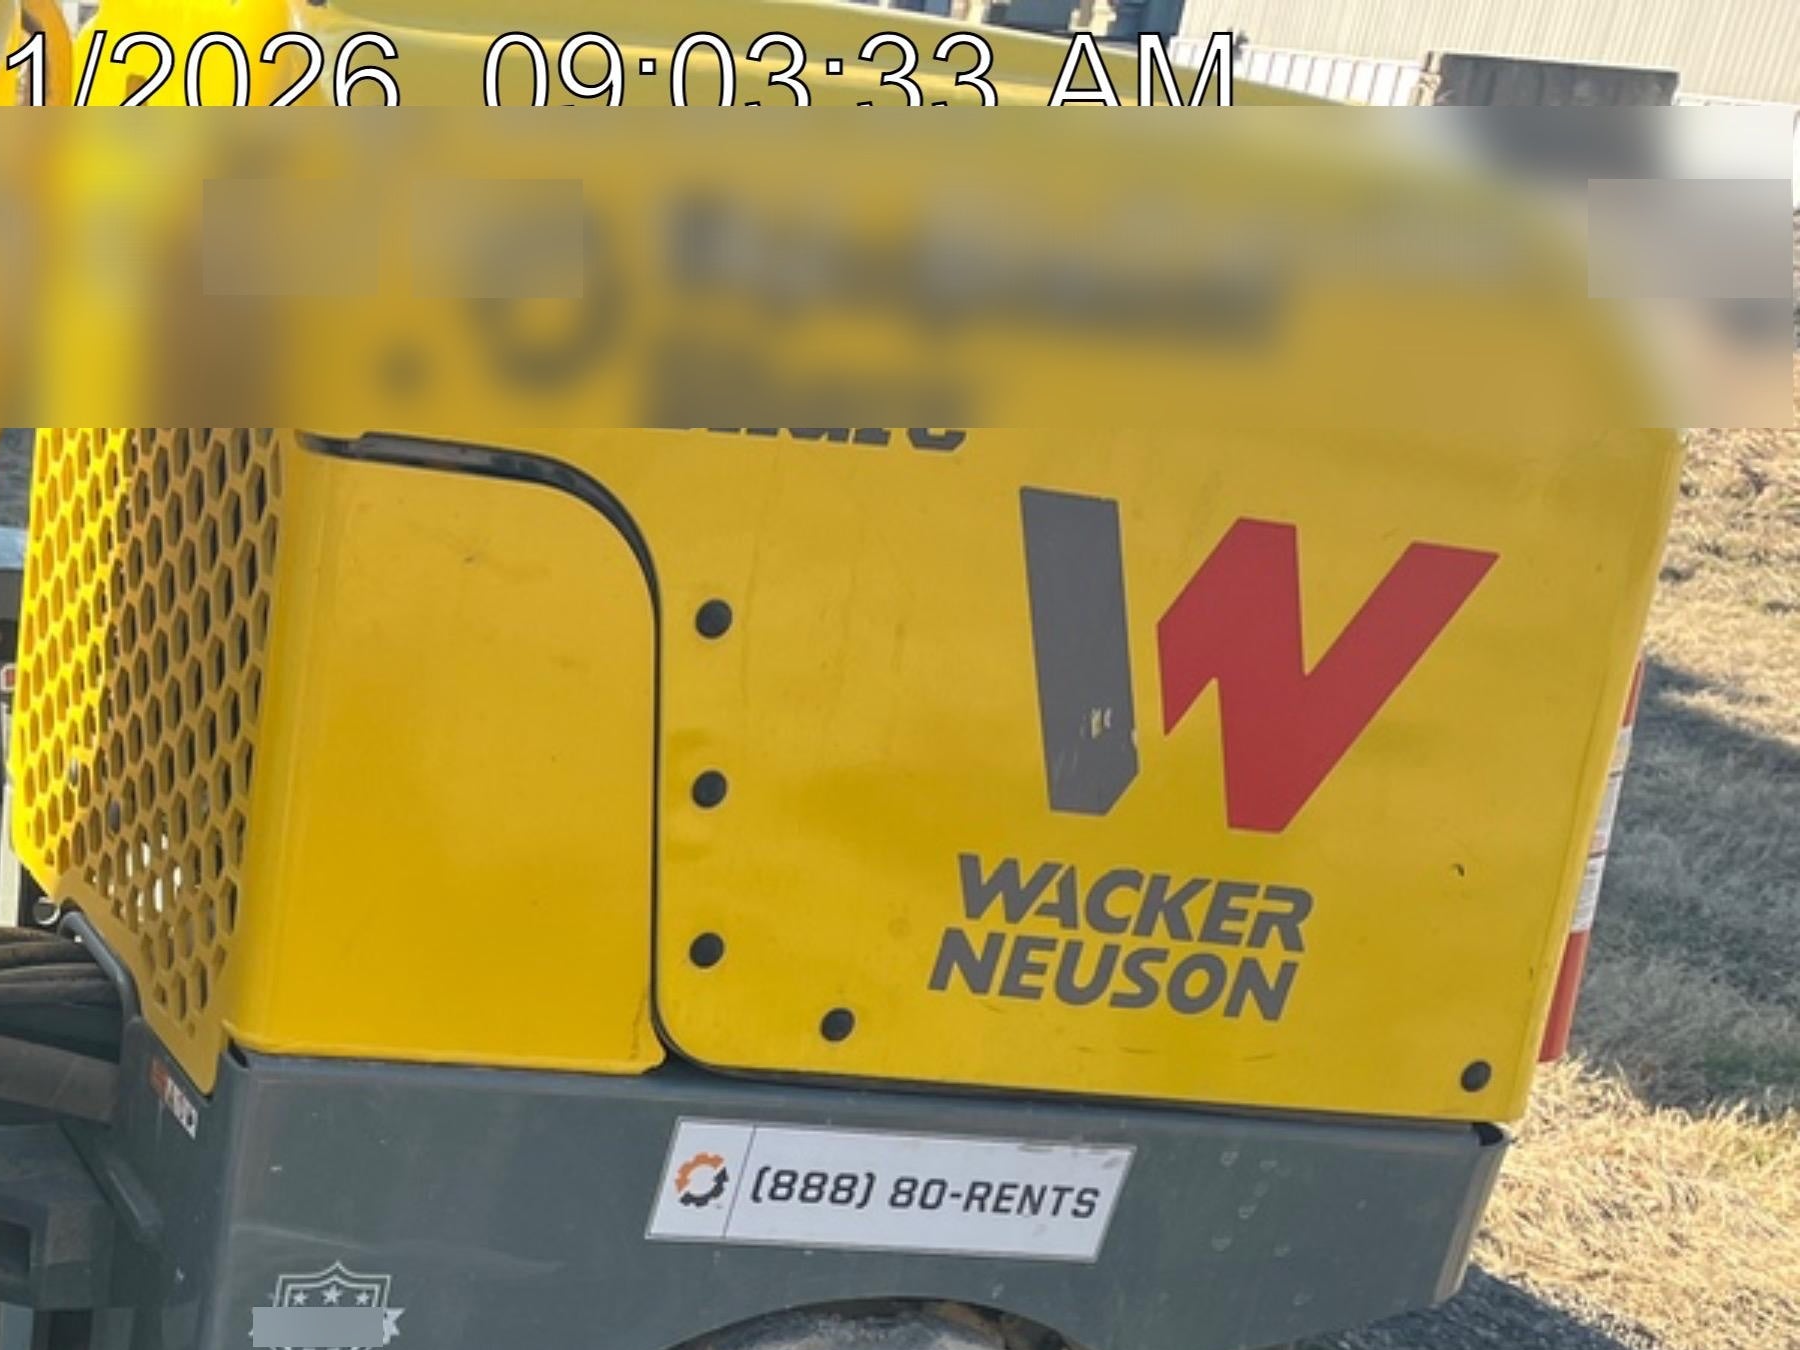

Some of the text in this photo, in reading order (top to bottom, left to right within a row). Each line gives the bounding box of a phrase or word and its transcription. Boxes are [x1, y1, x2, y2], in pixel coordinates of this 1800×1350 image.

[958, 852, 1313, 952] WACKER
[927, 927, 1299, 1022] NEUSON
[751, 1167, 1100, 1219] (888) 80-RENTS
